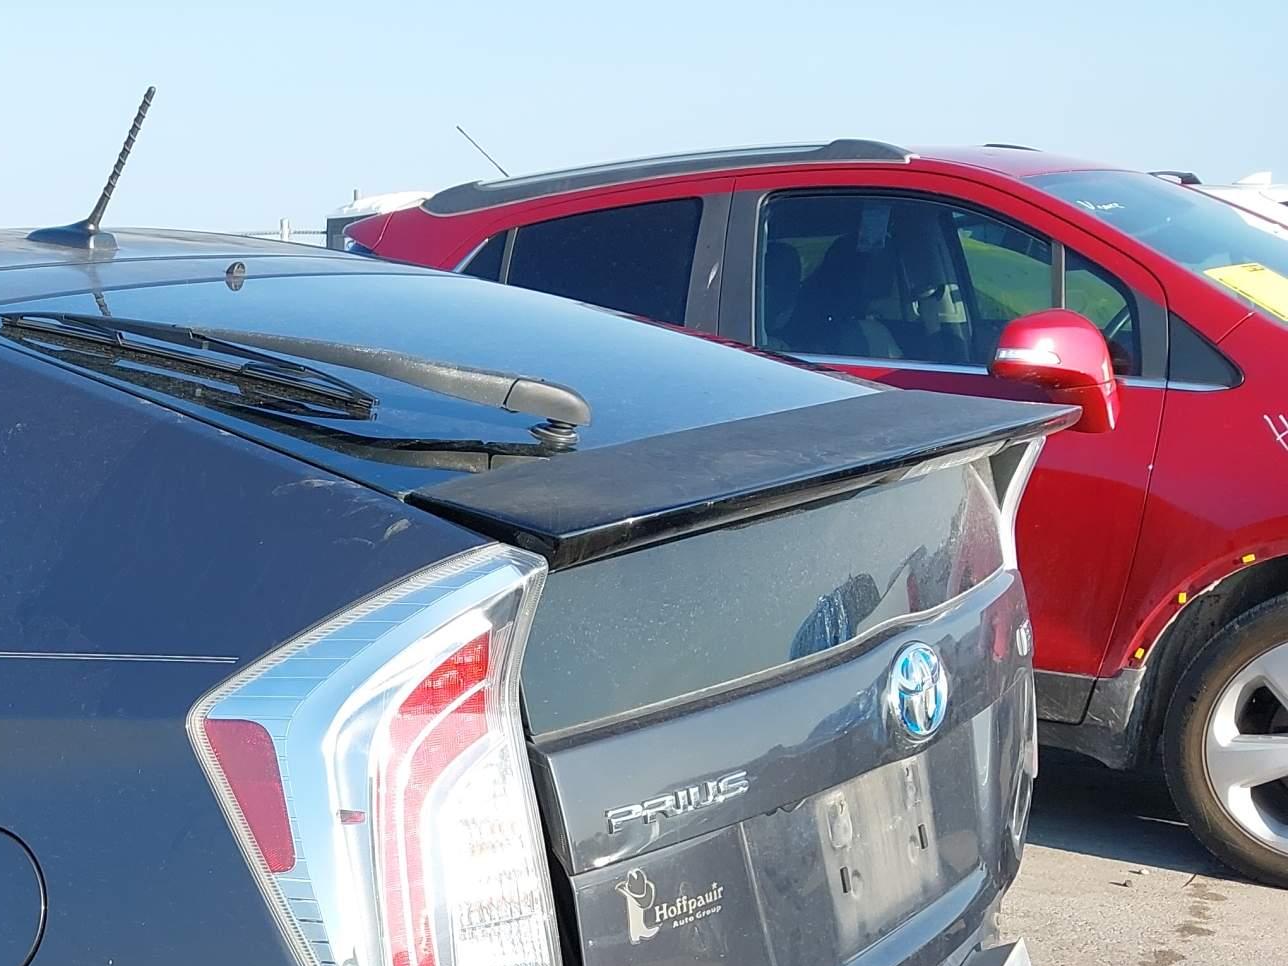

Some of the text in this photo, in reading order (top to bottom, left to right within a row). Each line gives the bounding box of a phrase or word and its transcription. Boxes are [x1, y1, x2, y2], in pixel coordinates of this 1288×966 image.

[605, 770, 750, 834] PRIUS
[654, 882, 724, 923] Hoffpauir
[672, 904, 722, 929] Auto Group
